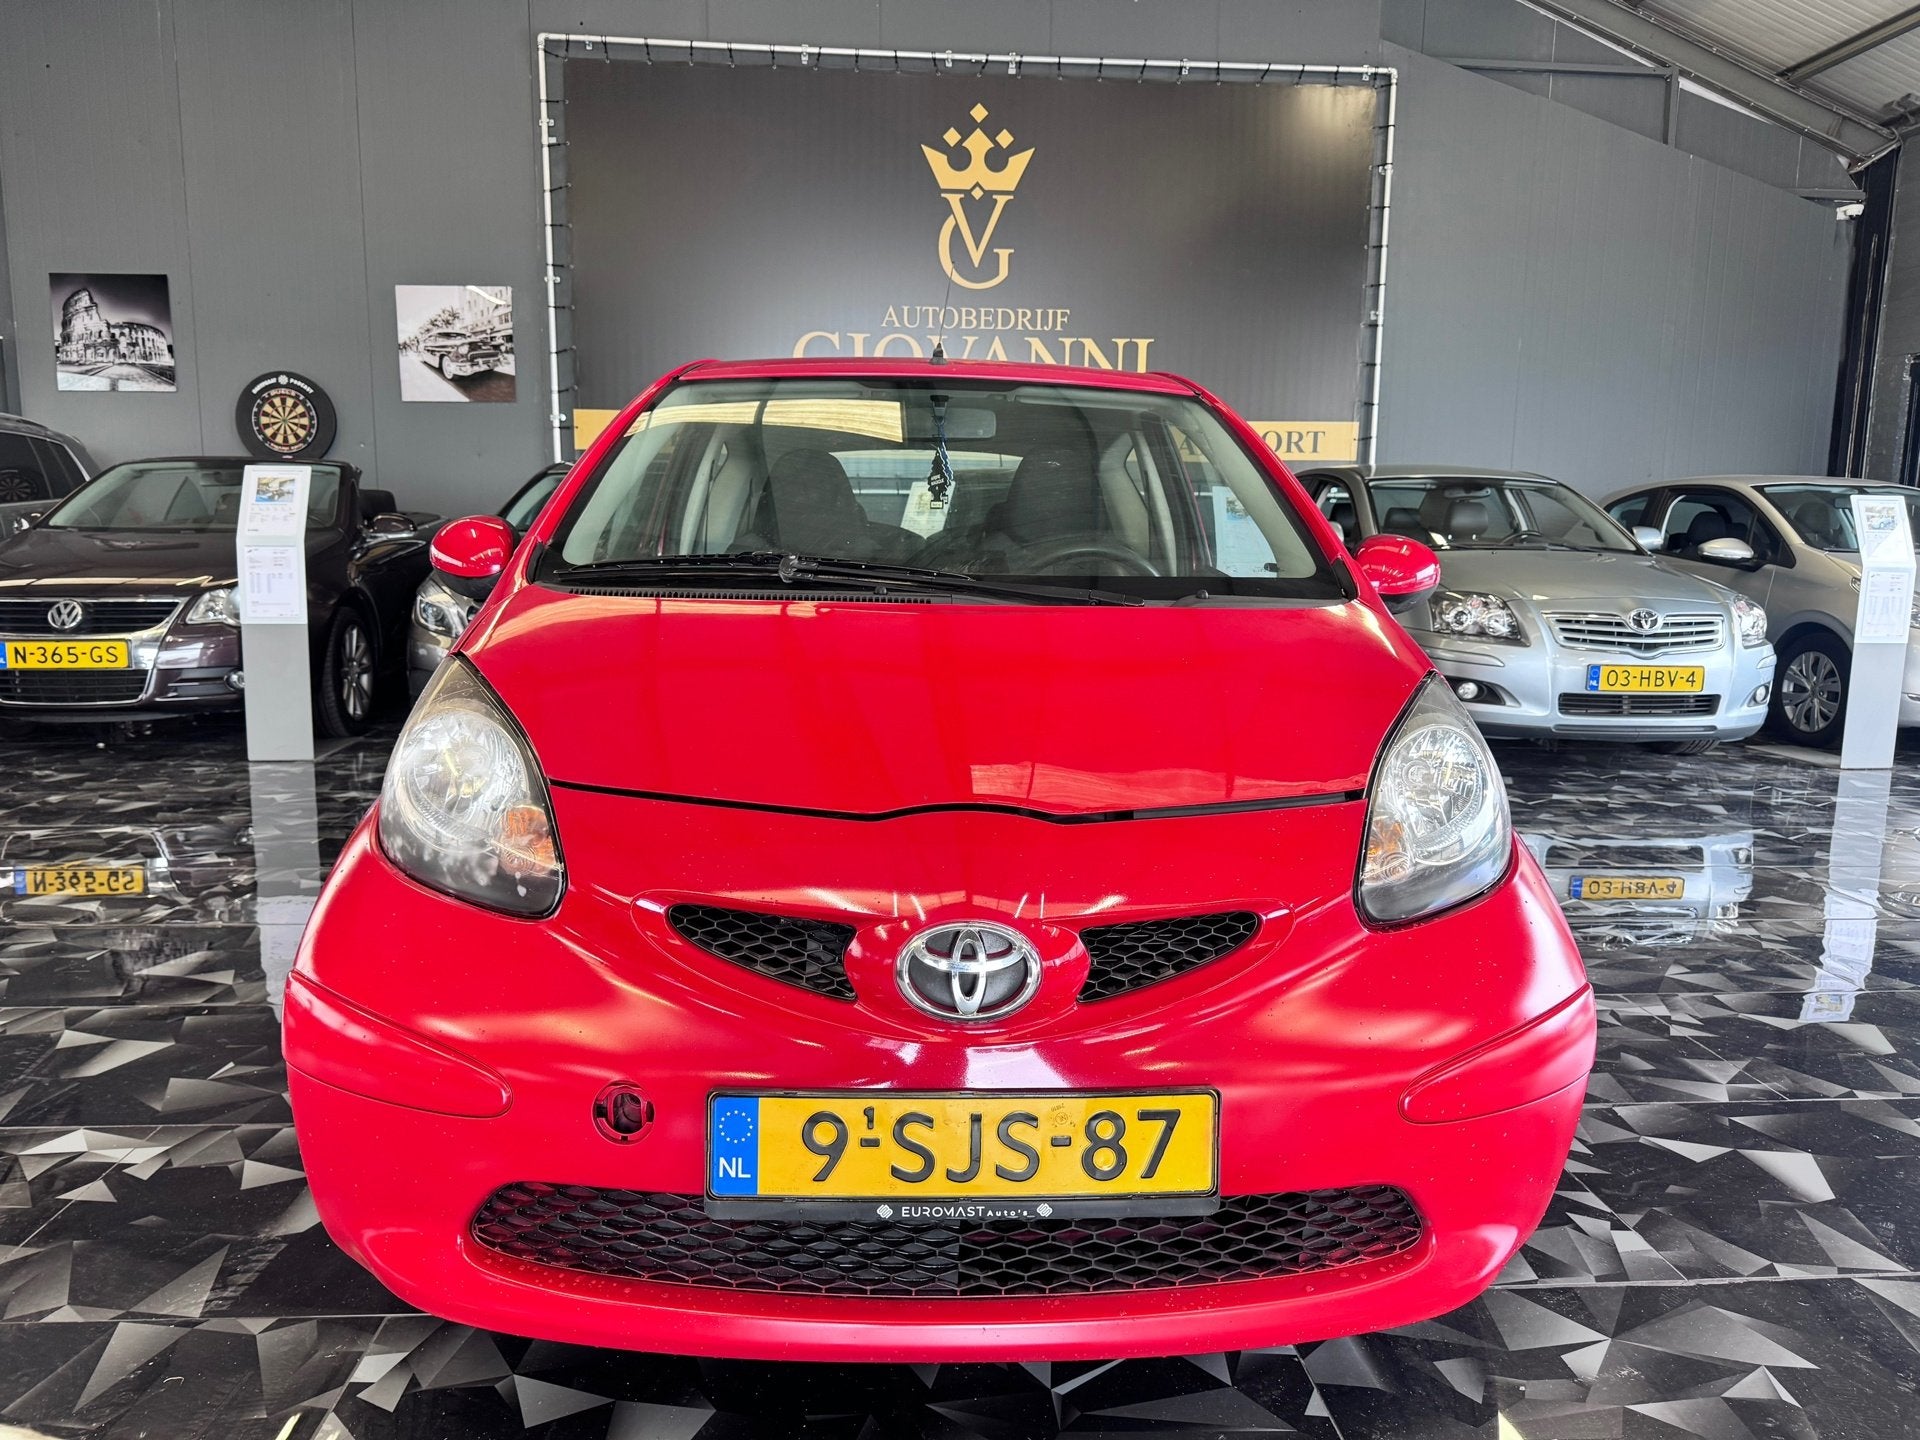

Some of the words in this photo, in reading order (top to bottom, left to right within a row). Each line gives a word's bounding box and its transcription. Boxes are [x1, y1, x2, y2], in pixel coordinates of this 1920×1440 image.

[881, 305, 1070, 331] AUTOBEDRIJF
[14, 646, 118, 664] N-365-GS
[1606, 669, 1696, 687] 03-HBV-4
[718, 1157, 751, 1178] NL
[901, 1206, 986, 1218] EUROMAST
